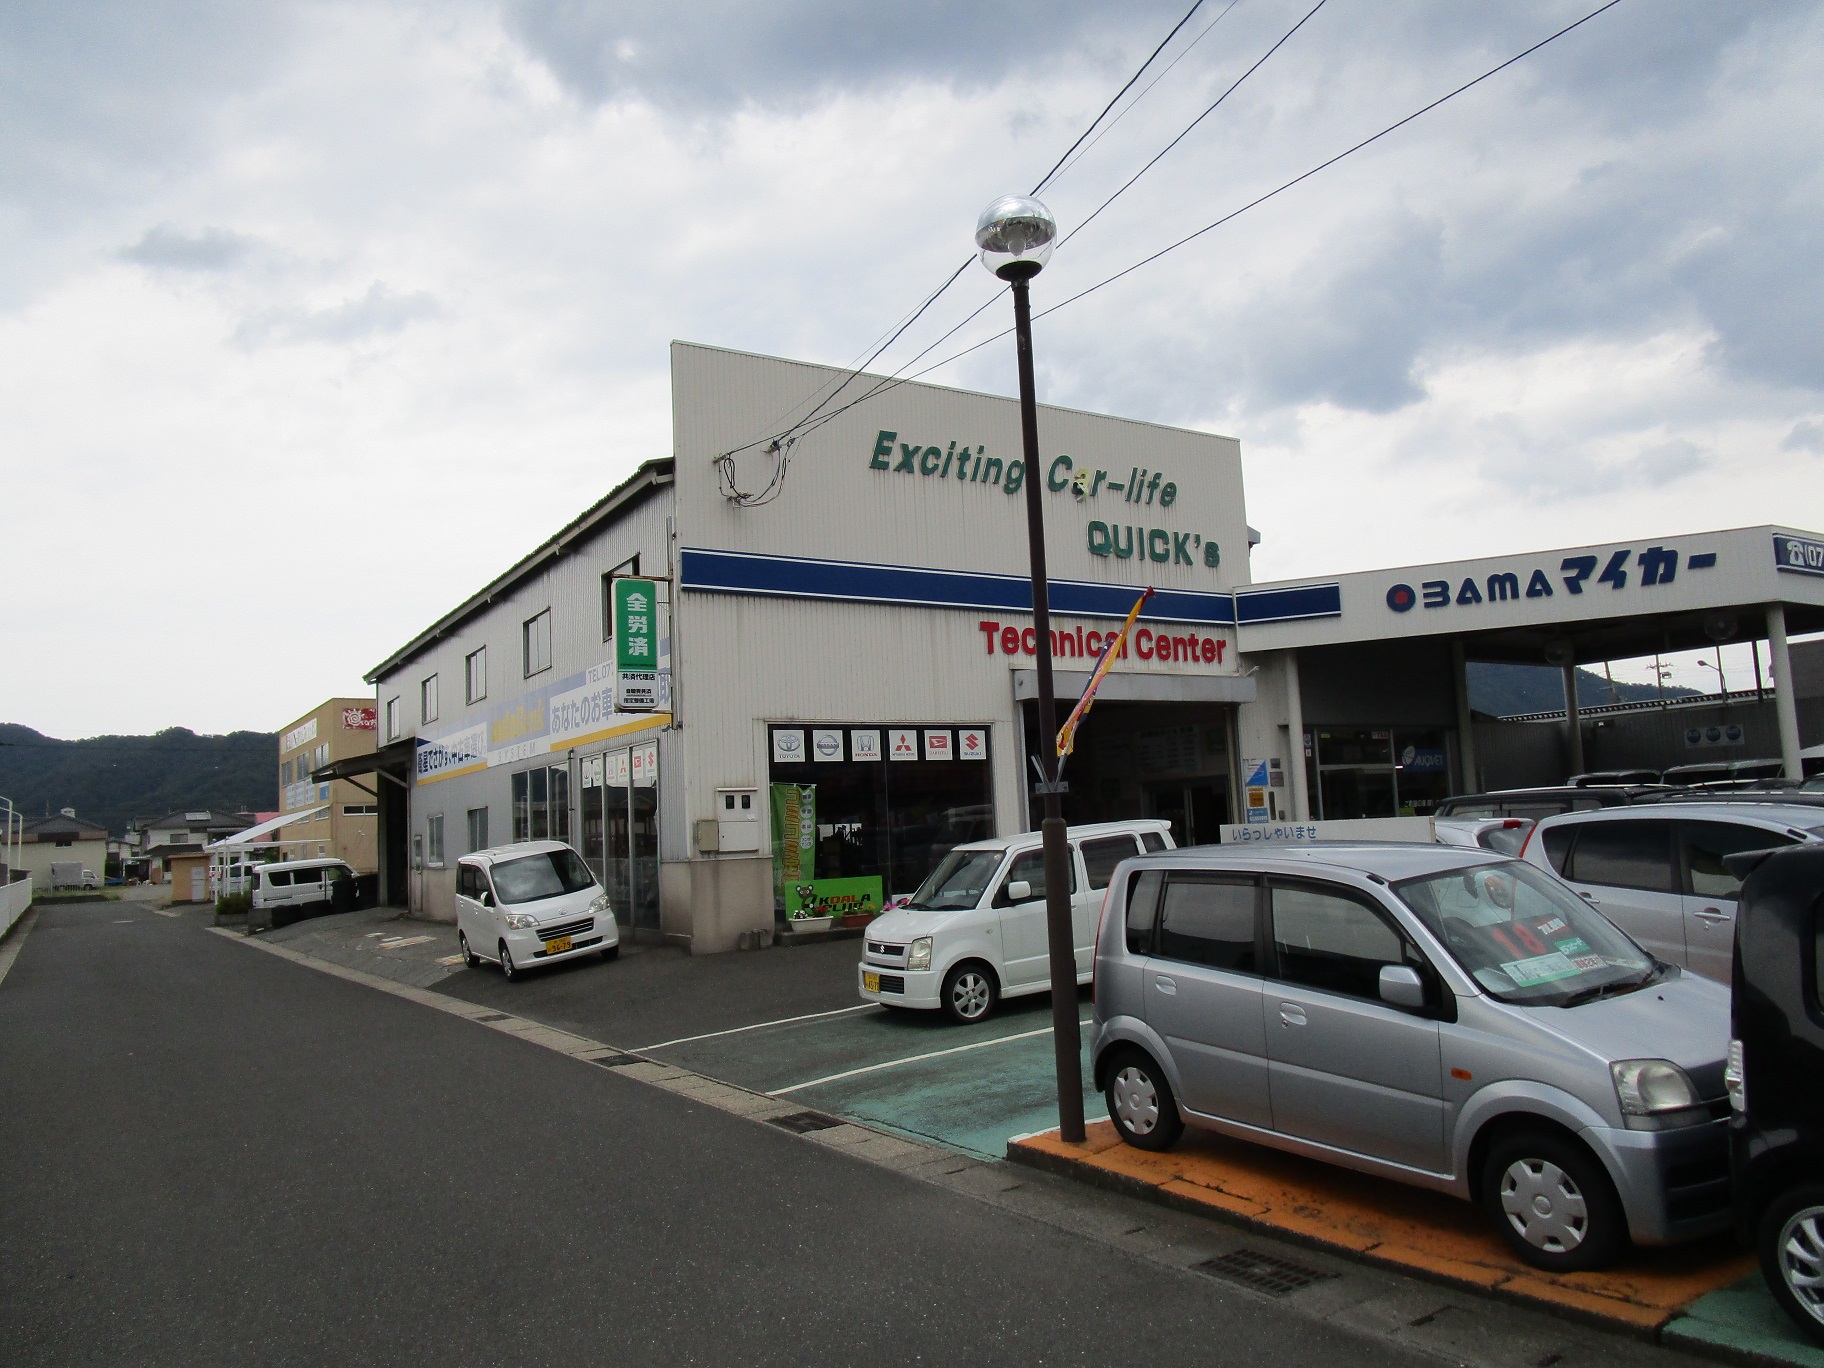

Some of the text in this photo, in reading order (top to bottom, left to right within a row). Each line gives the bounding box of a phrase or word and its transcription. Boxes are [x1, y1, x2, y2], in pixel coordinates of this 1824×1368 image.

[869, 430, 1177, 507] Exciting Car-life
[1087, 520, 1221, 568] QUICK's
[627, 592, 648, 657] 全労済
[1135, 628, 1227, 664] Center
[1232, 825, 1317, 841] いらっしゃいませ
[819, 894, 871, 905] KOALA
